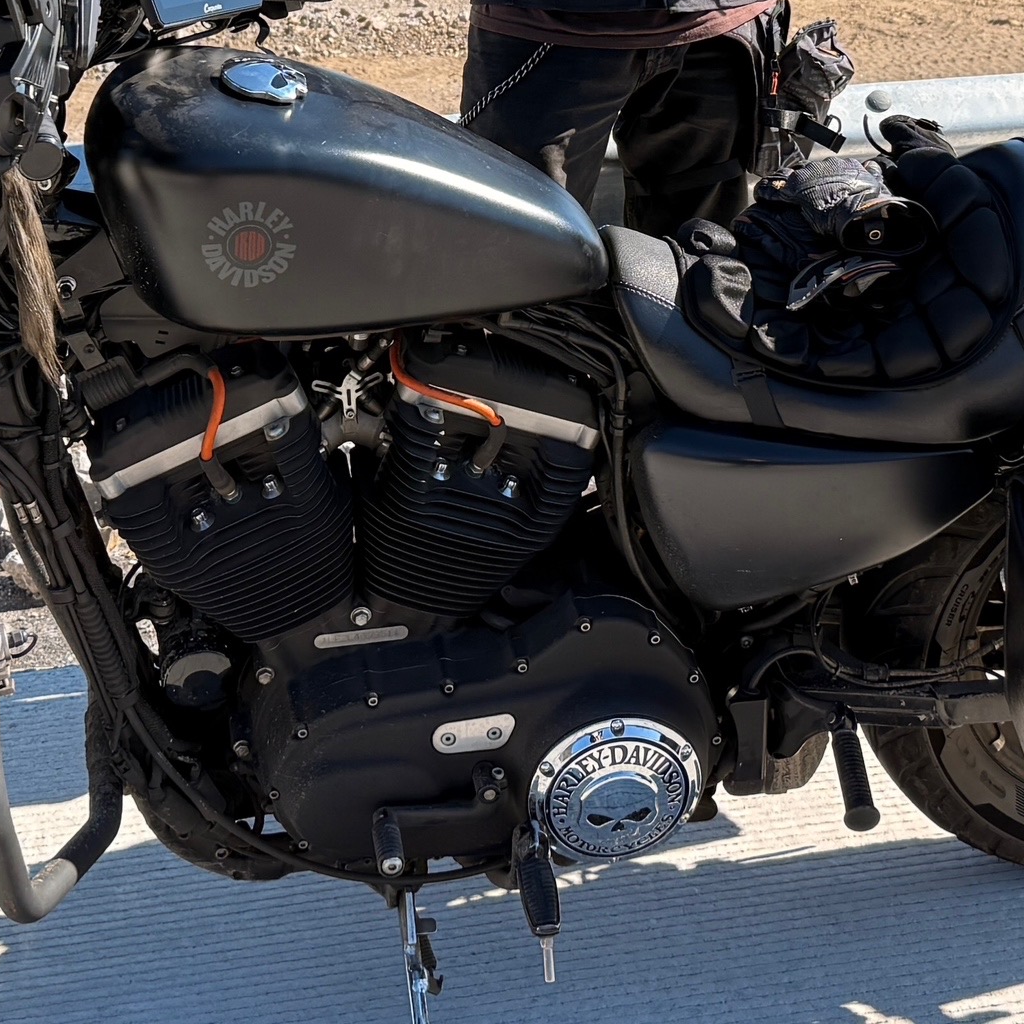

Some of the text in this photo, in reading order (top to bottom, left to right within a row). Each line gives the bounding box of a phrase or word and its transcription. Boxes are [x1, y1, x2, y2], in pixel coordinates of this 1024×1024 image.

[207, 201, 294, 237] HARLEY
[201, 242, 297, 288] DAVIDSON
[945, 583, 969, 627] CRUISER
[552, 744, 683, 818] HARLEY-DAVIDSON
[559, 813, 675, 854] MOTORCYCLES
